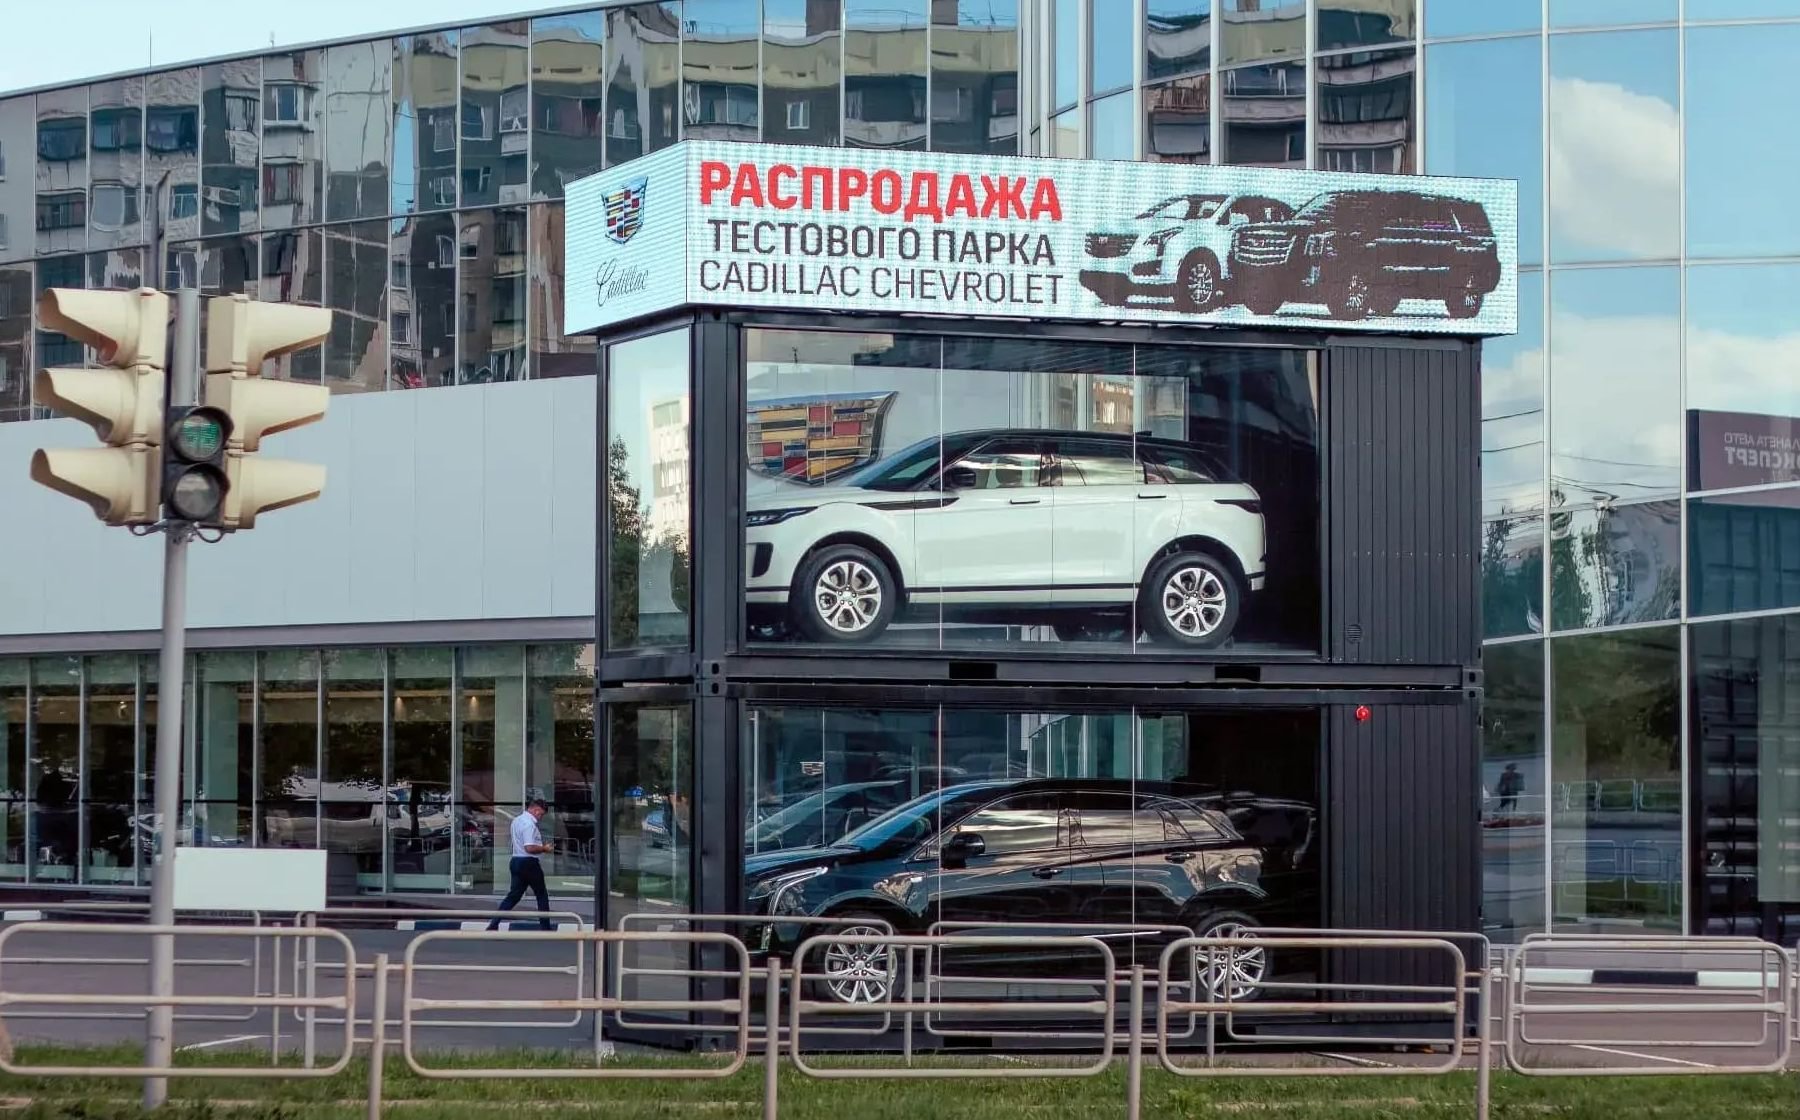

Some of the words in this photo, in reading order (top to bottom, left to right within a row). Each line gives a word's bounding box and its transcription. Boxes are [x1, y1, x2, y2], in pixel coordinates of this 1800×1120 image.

[700, 161, 1062, 223] РАСПРОДАЖА
[707, 218, 921, 260] ТЕСТОВОГО
[932, 229, 1056, 266] ПАРКА
[596, 258, 648, 307] Cadillac
[700, 259, 860, 298] CADILLAC
[871, 267, 1064, 305] CHEVROLET
